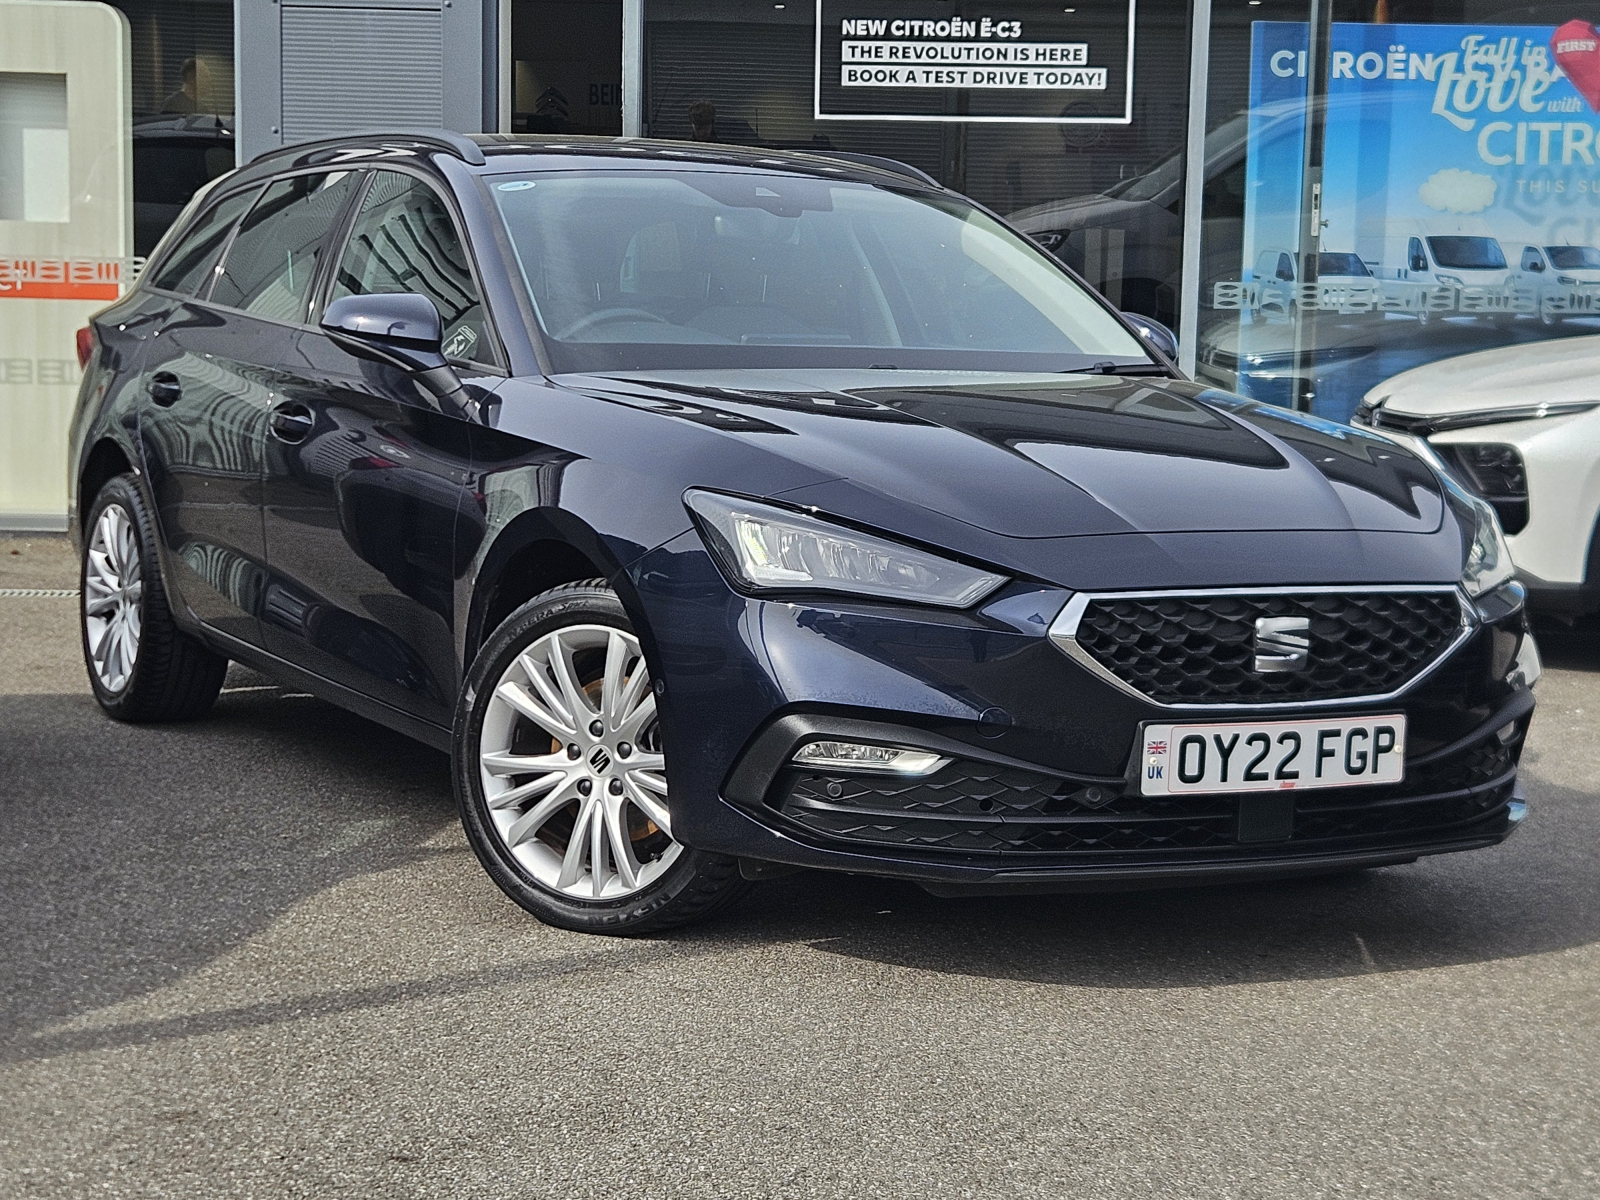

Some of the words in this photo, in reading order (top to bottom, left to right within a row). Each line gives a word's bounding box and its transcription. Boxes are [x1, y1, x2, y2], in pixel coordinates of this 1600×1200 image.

[842, 19, 887, 36] NEW
[890, 16, 976, 37] CITROËN
[980, 17, 1022, 38] Ë-C3
[848, 45, 884, 58] THE
[889, 46, 1008, 60] REVOLUTION
[1014, 48, 1030, 60] IS
[1035, 48, 1083, 61] HERE
[1460, 34, 1518, 65] Fall
[1520, 39, 1547, 65] in
[1556, 38, 1596, 54] FIRST
[1270, 44, 1434, 82] CIROËN
[848, 69, 900, 83] BOOK
[905, 70, 917, 83] A
[922, 70, 968, 84] TEST
[973, 71, 1029, 85] DRIVE
[1033, 72, 1102, 86] TODAY!
[1431, 52, 1550, 132] Love
[1547, 97, 1582, 113] with
[1477, 121, 1600, 166] CITR
[1516, 180, 1565, 194] THIS
[1177, 730, 1301, 784] OY22
[1315, 725, 1396, 778] FGP
[1147, 765, 1164, 780] UK
